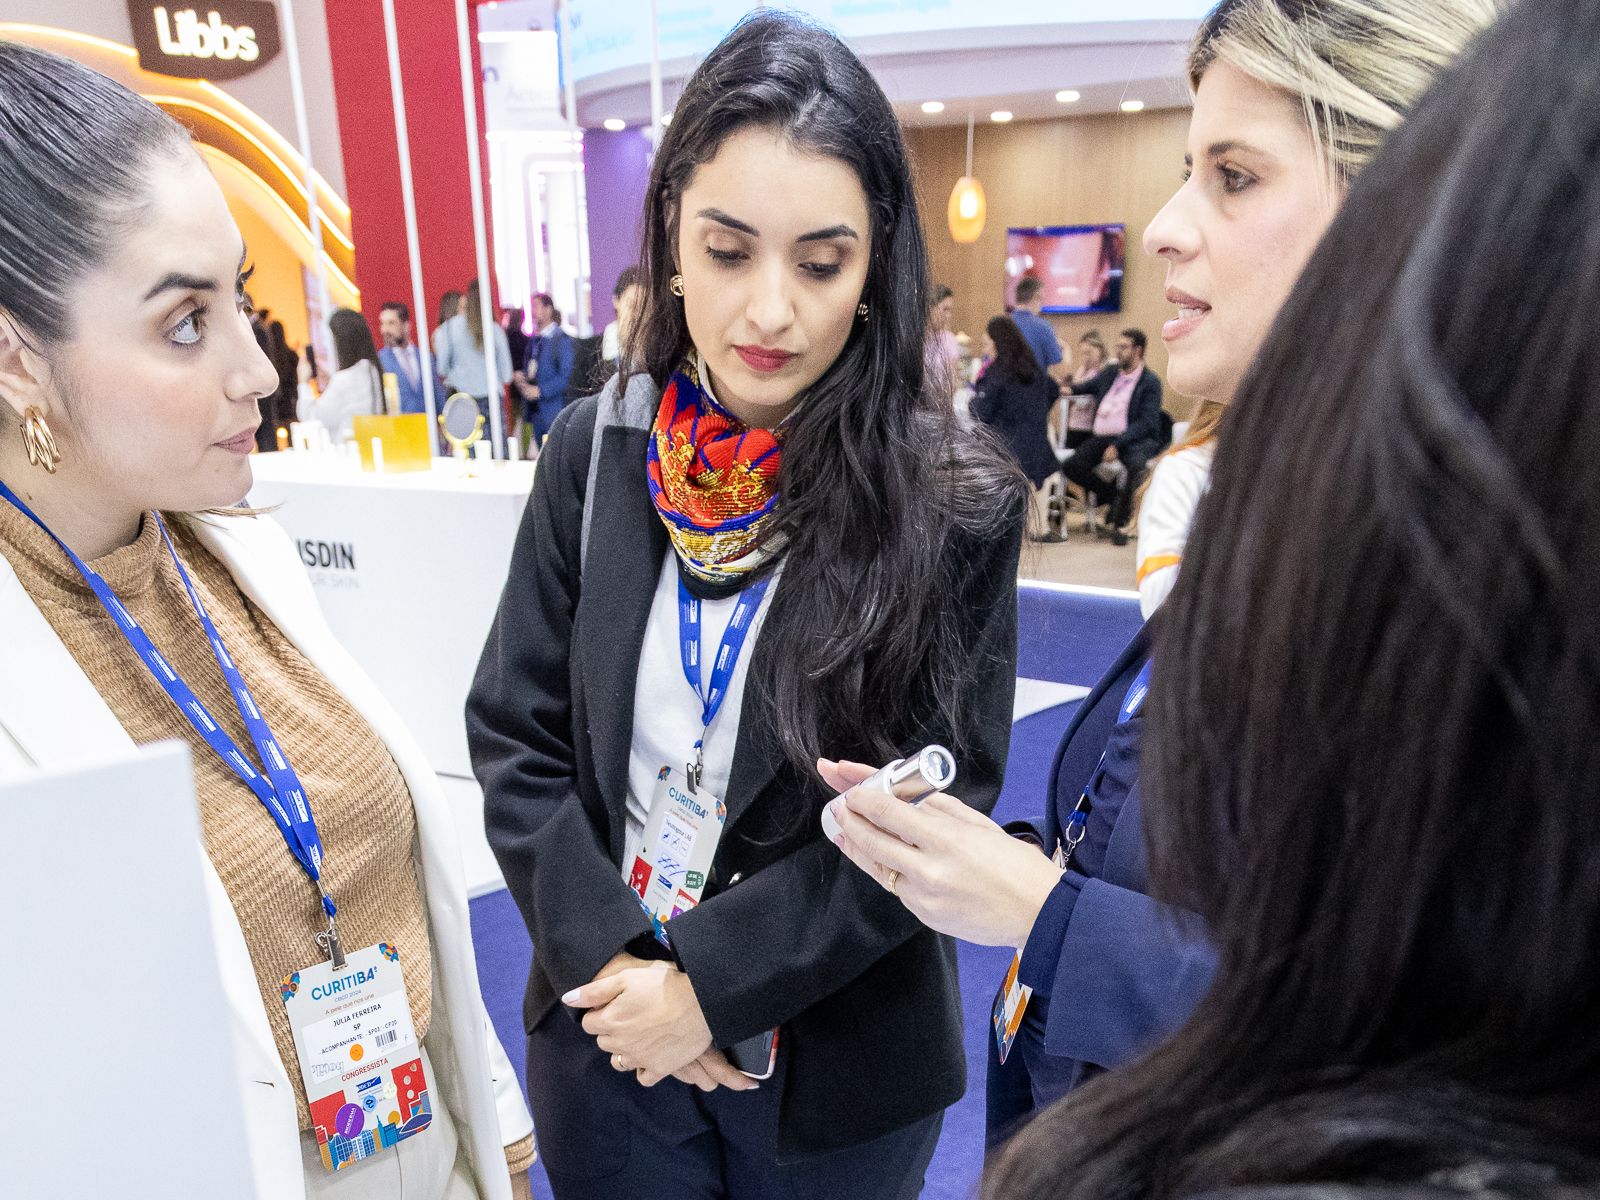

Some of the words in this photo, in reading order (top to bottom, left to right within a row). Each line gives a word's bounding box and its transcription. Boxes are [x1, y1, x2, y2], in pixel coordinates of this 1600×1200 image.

[153, 6, 259, 61] Libbs
[296, 539, 355, 570] ISDIN
[669, 787, 706, 819] CURITIBA
[311, 967, 375, 1001] CURITIBA
[352, 1003, 382, 1019] FERREIRA
[353, 1023, 361, 1031] SP
[321, 1033, 363, 1054] ACOMPANHANTE
[342, 1058, 389, 1082] CONGRESSISTA
